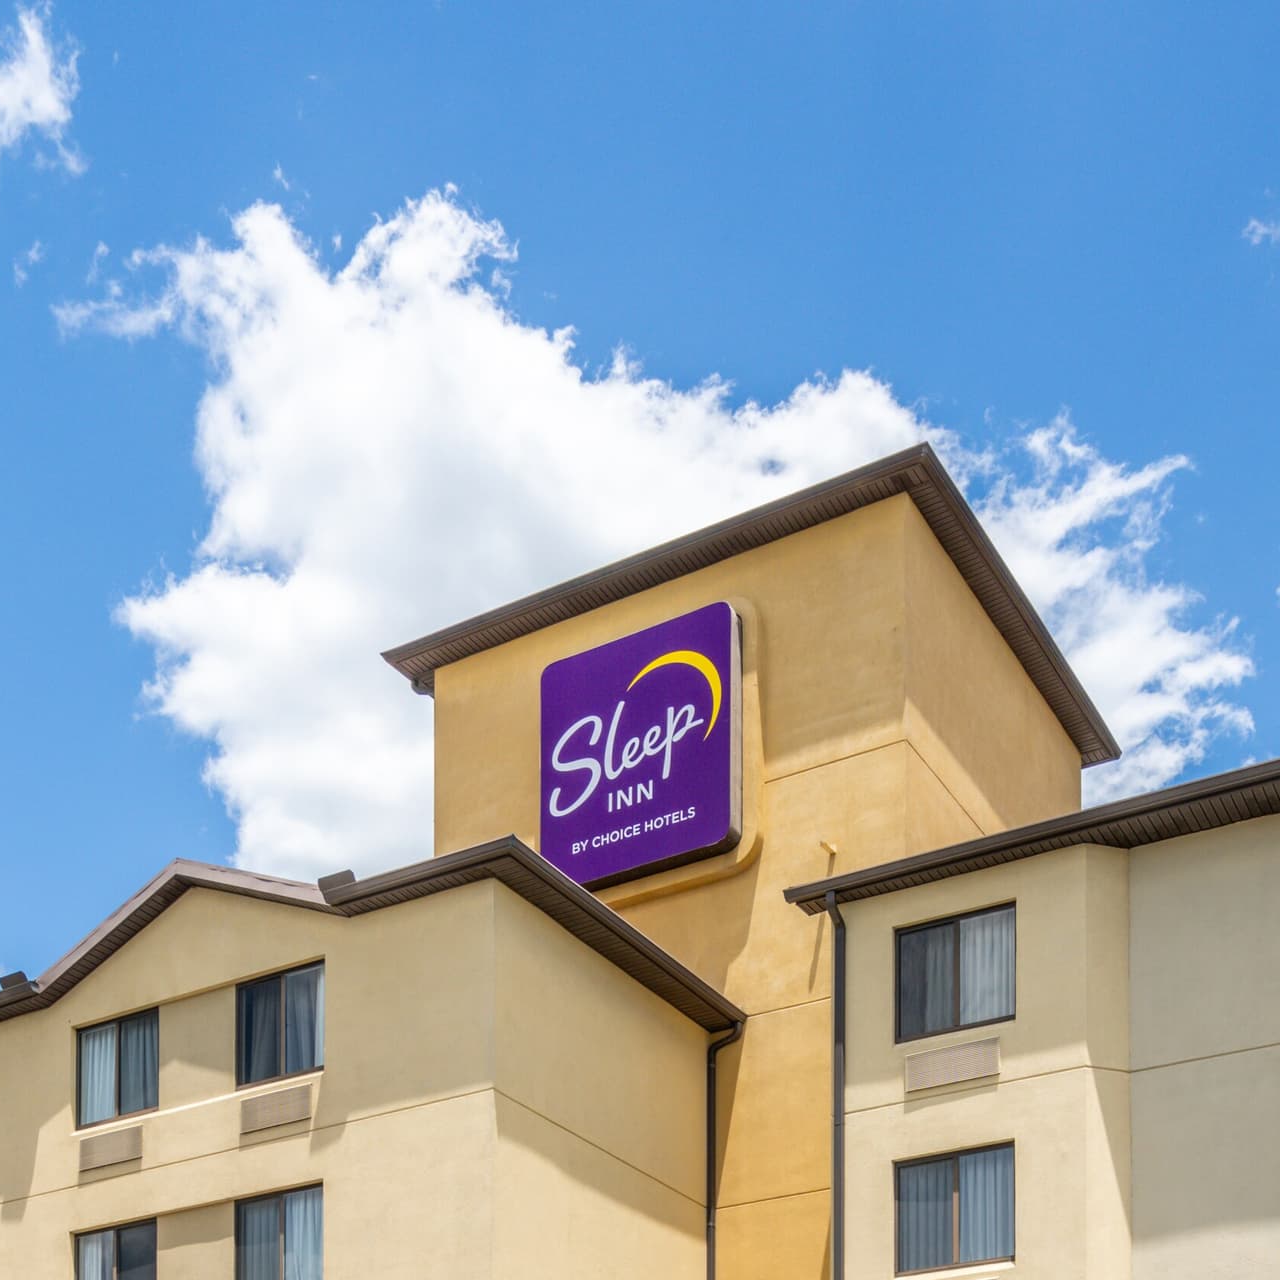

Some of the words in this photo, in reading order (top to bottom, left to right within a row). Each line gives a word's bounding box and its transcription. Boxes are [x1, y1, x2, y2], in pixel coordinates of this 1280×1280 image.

[549, 700, 704, 817] Sleep
[608, 780, 654, 812] INN
[572, 840, 589, 855] BY
[592, 824, 641, 848] CHOICE
[644, 807, 696, 832] HOTELS
